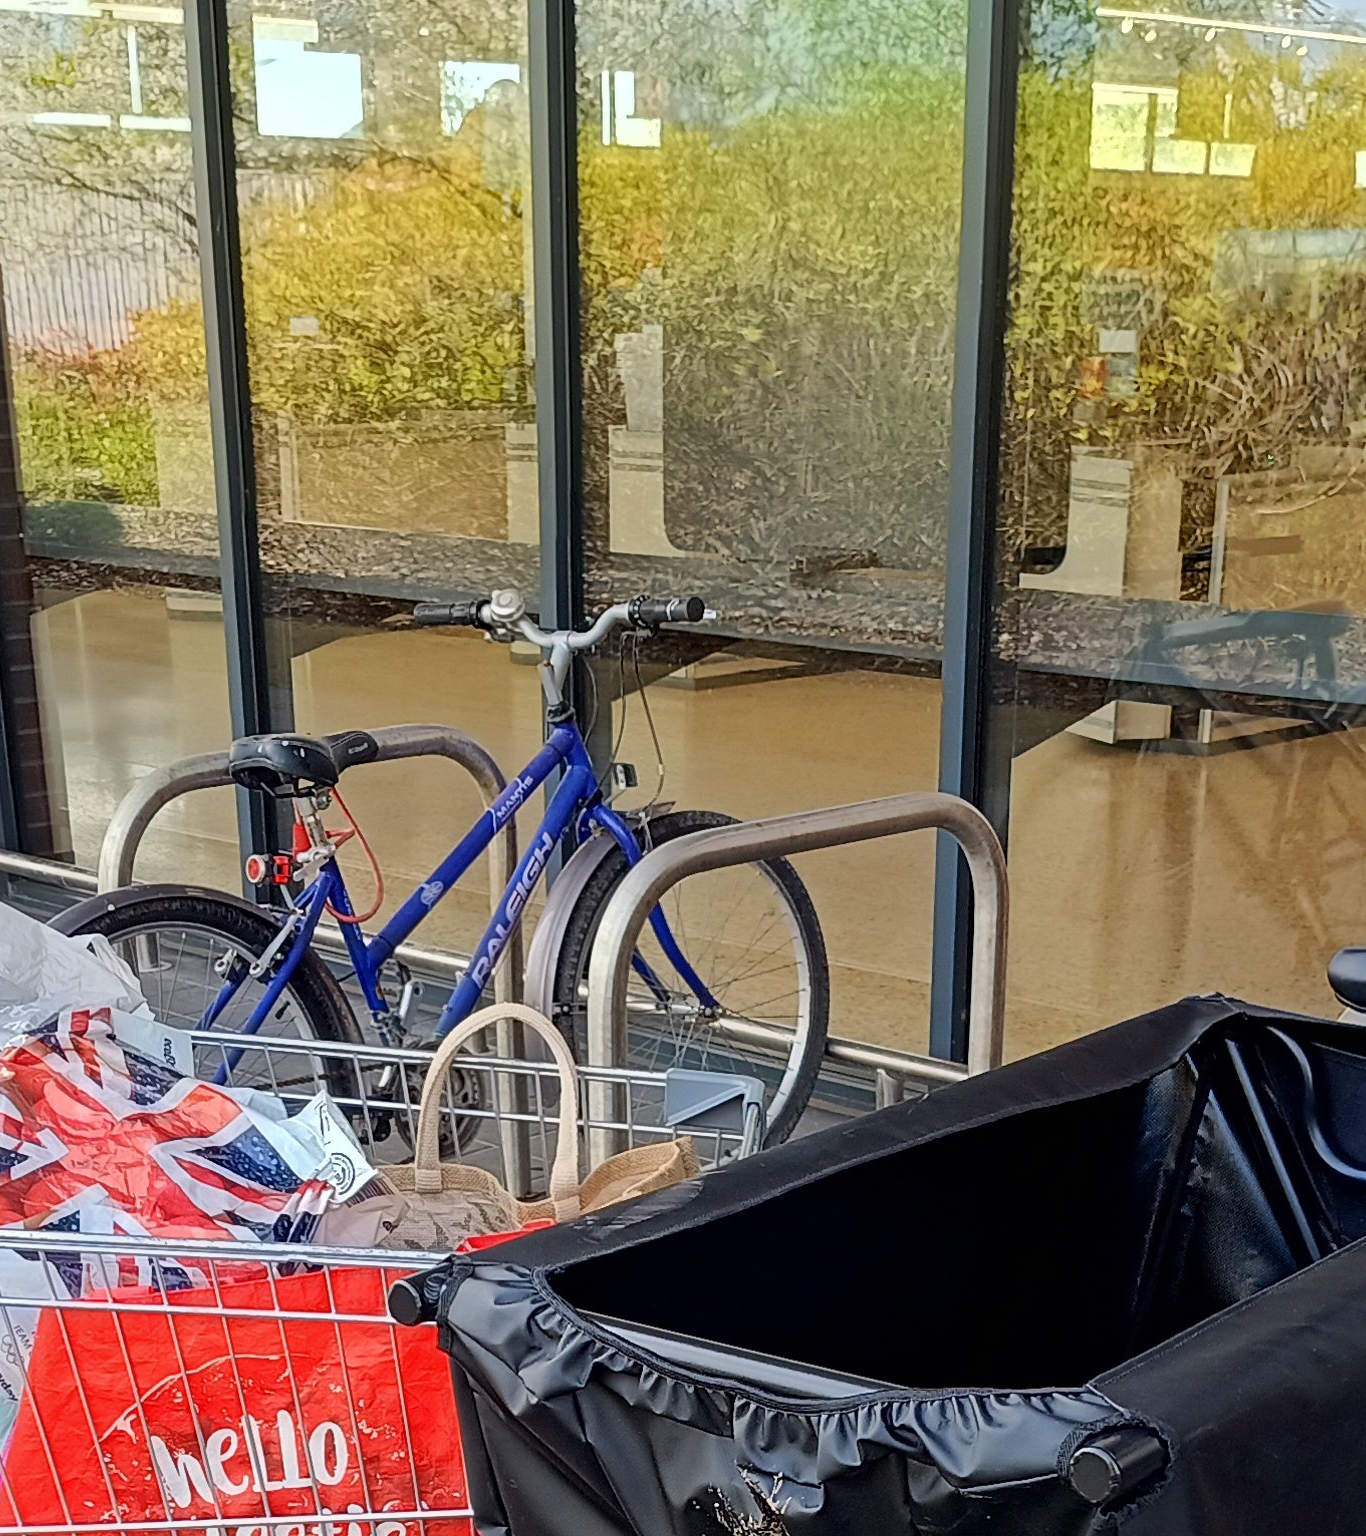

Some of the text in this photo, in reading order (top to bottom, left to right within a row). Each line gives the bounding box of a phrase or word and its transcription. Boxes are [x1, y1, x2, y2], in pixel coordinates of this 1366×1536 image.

[496, 775, 534, 818] MANTIS
[471, 831, 554, 989] RALEIGH
[13, 1324, 33, 1350] TEAM
